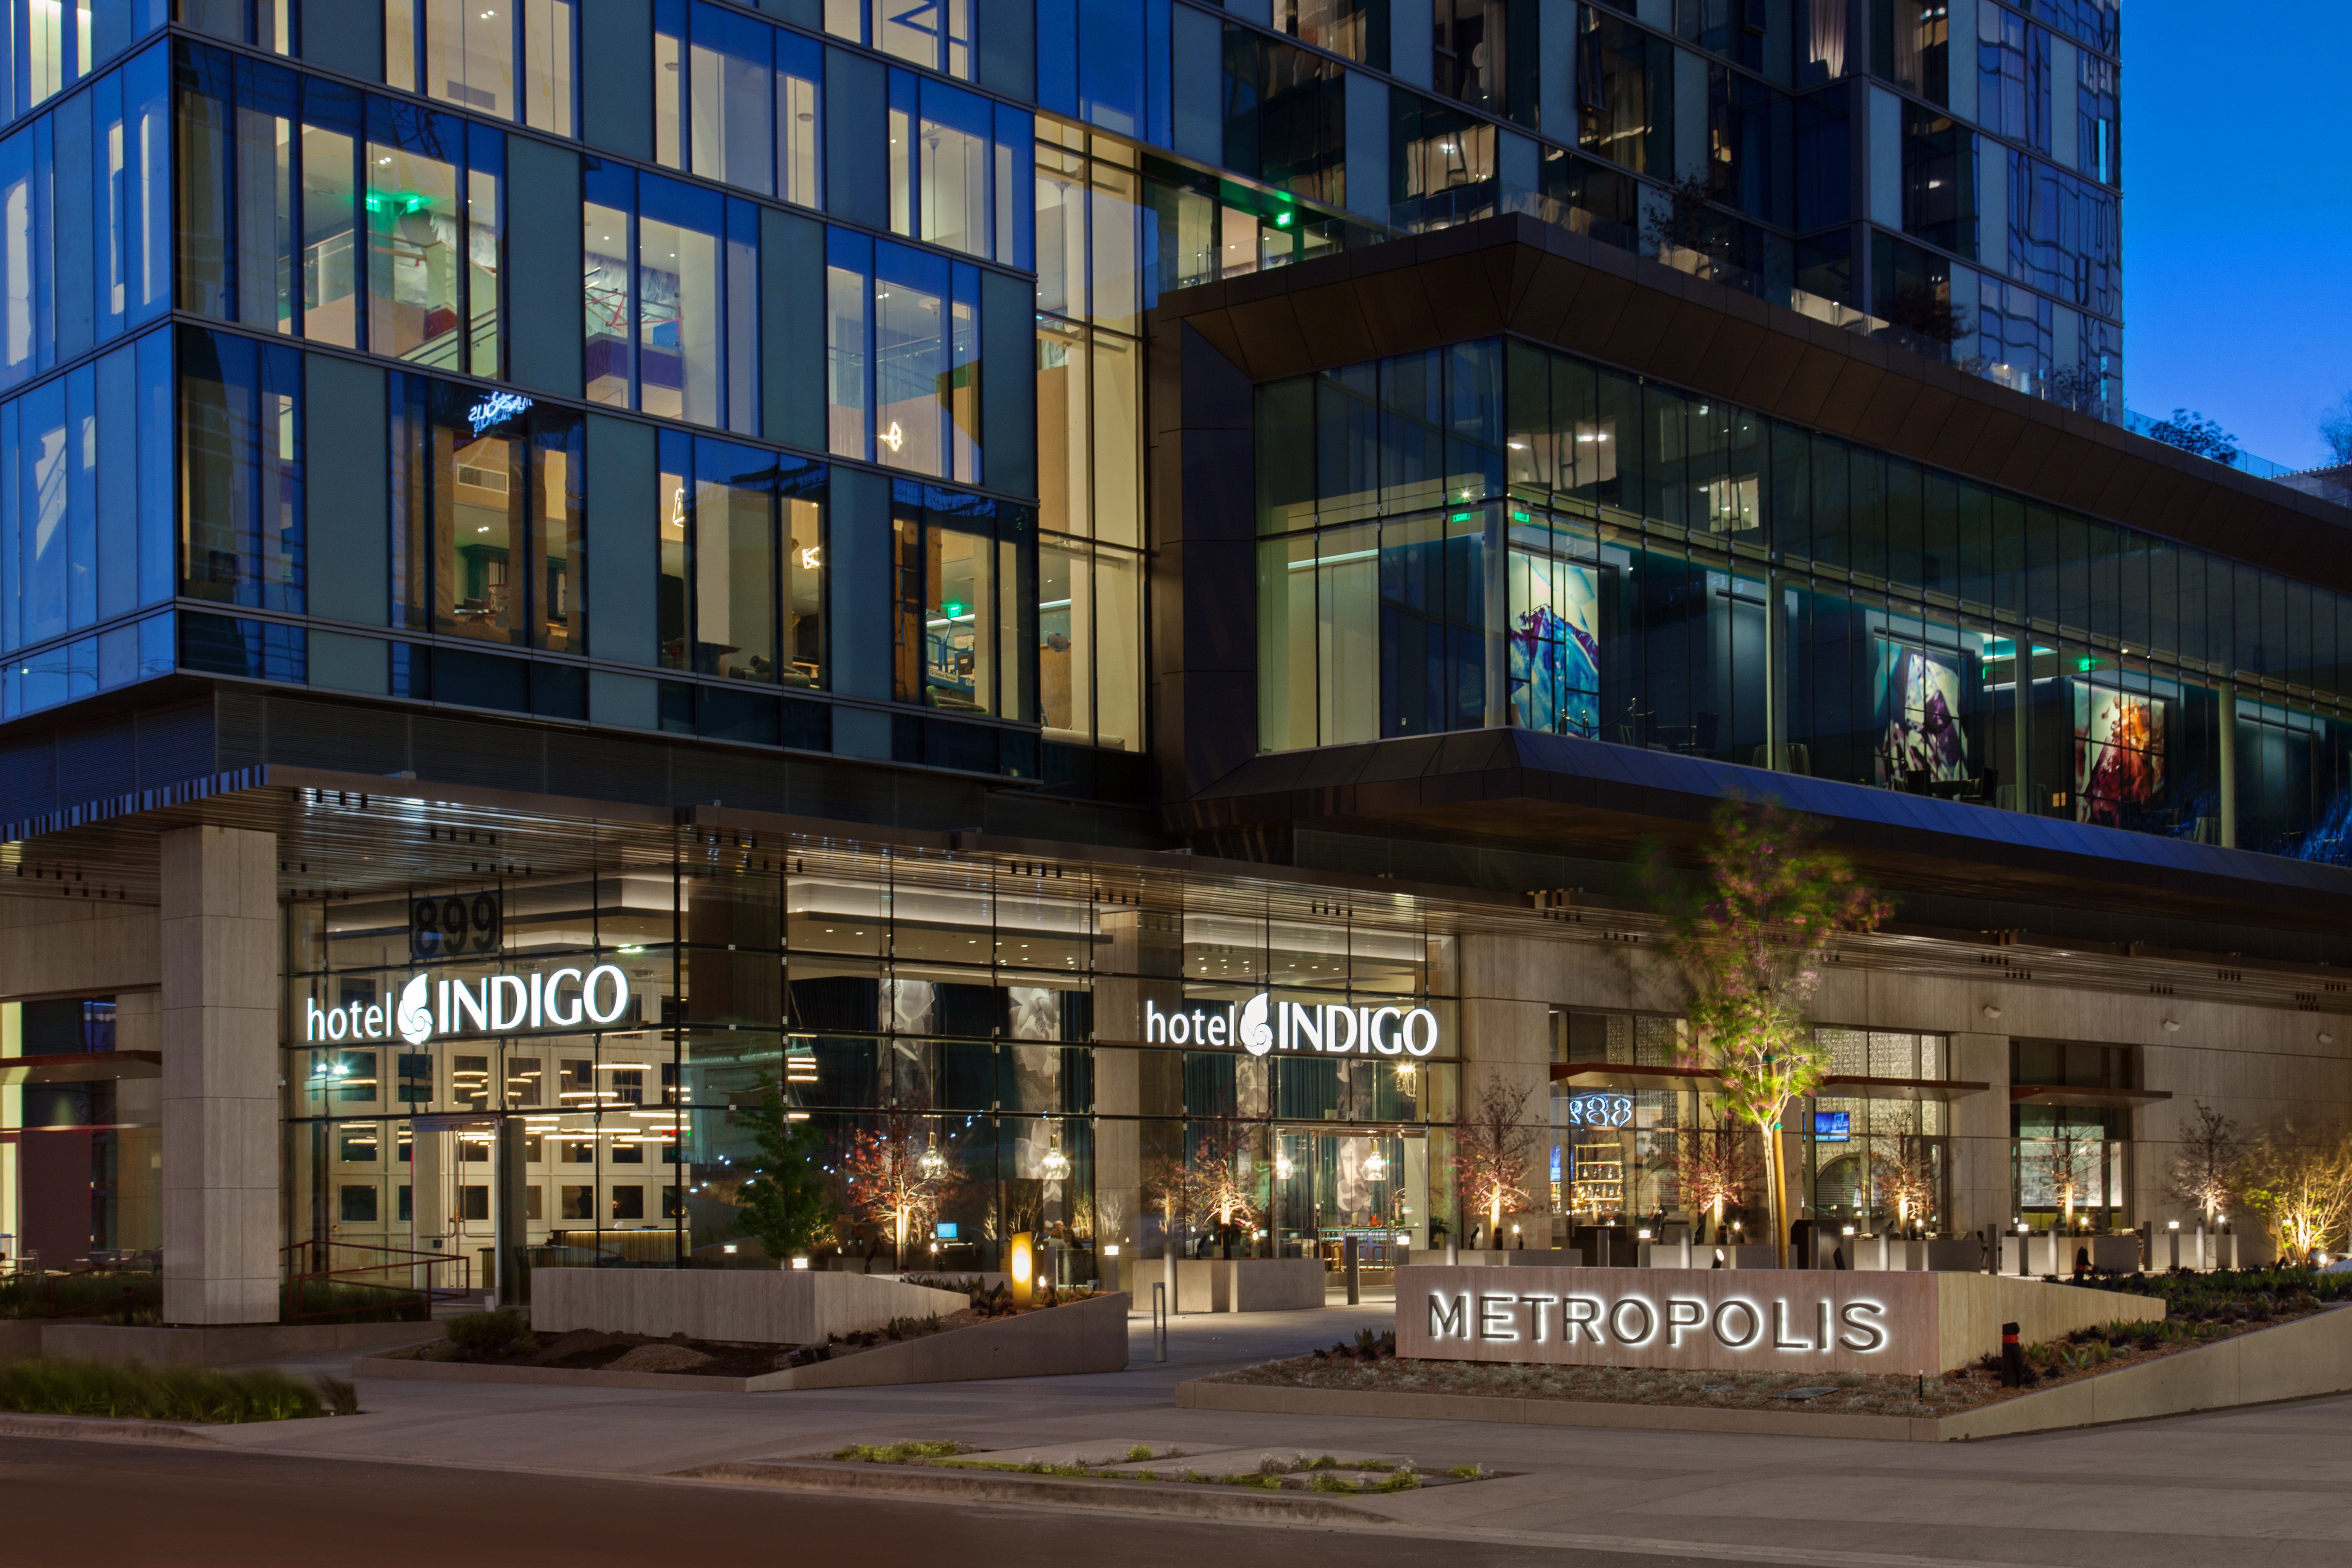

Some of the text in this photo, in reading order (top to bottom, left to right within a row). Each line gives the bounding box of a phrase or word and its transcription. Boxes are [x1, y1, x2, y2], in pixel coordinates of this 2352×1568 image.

[415, 893, 497, 956] 899
[307, 965, 628, 1041] hotel INDIGO
[1147, 1000, 1438, 1056] hotel INDIGO
[1427, 1294, 1886, 1352] METROPOLIS
